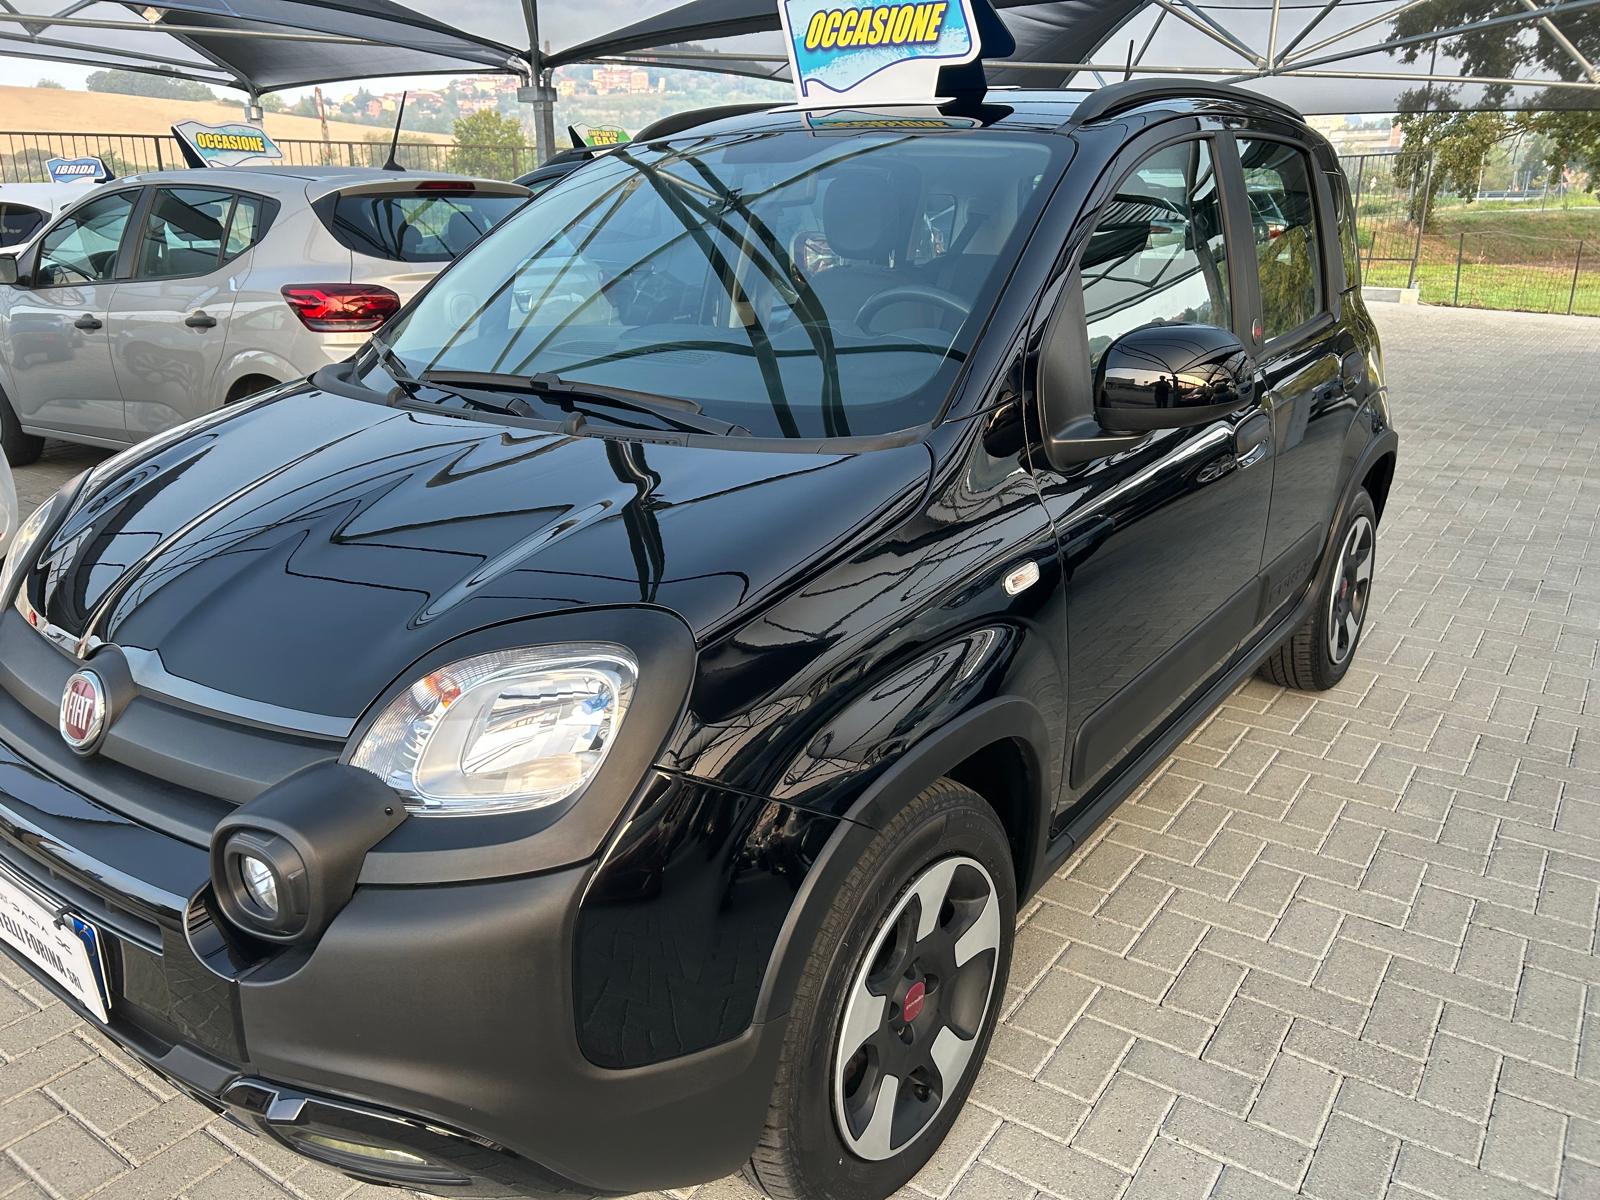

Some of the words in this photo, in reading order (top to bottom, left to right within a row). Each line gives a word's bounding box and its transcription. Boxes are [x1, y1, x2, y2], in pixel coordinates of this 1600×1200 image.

[804, 2, 948, 49] OCCASIONE
[196, 132, 265, 152] OCCASIONE
[55, 164, 96, 175] IBRIDA
[66, 690, 93, 731] FIAT
[23, 928, 67, 978] FORINA
[66, 967, 84, 993] SRL
